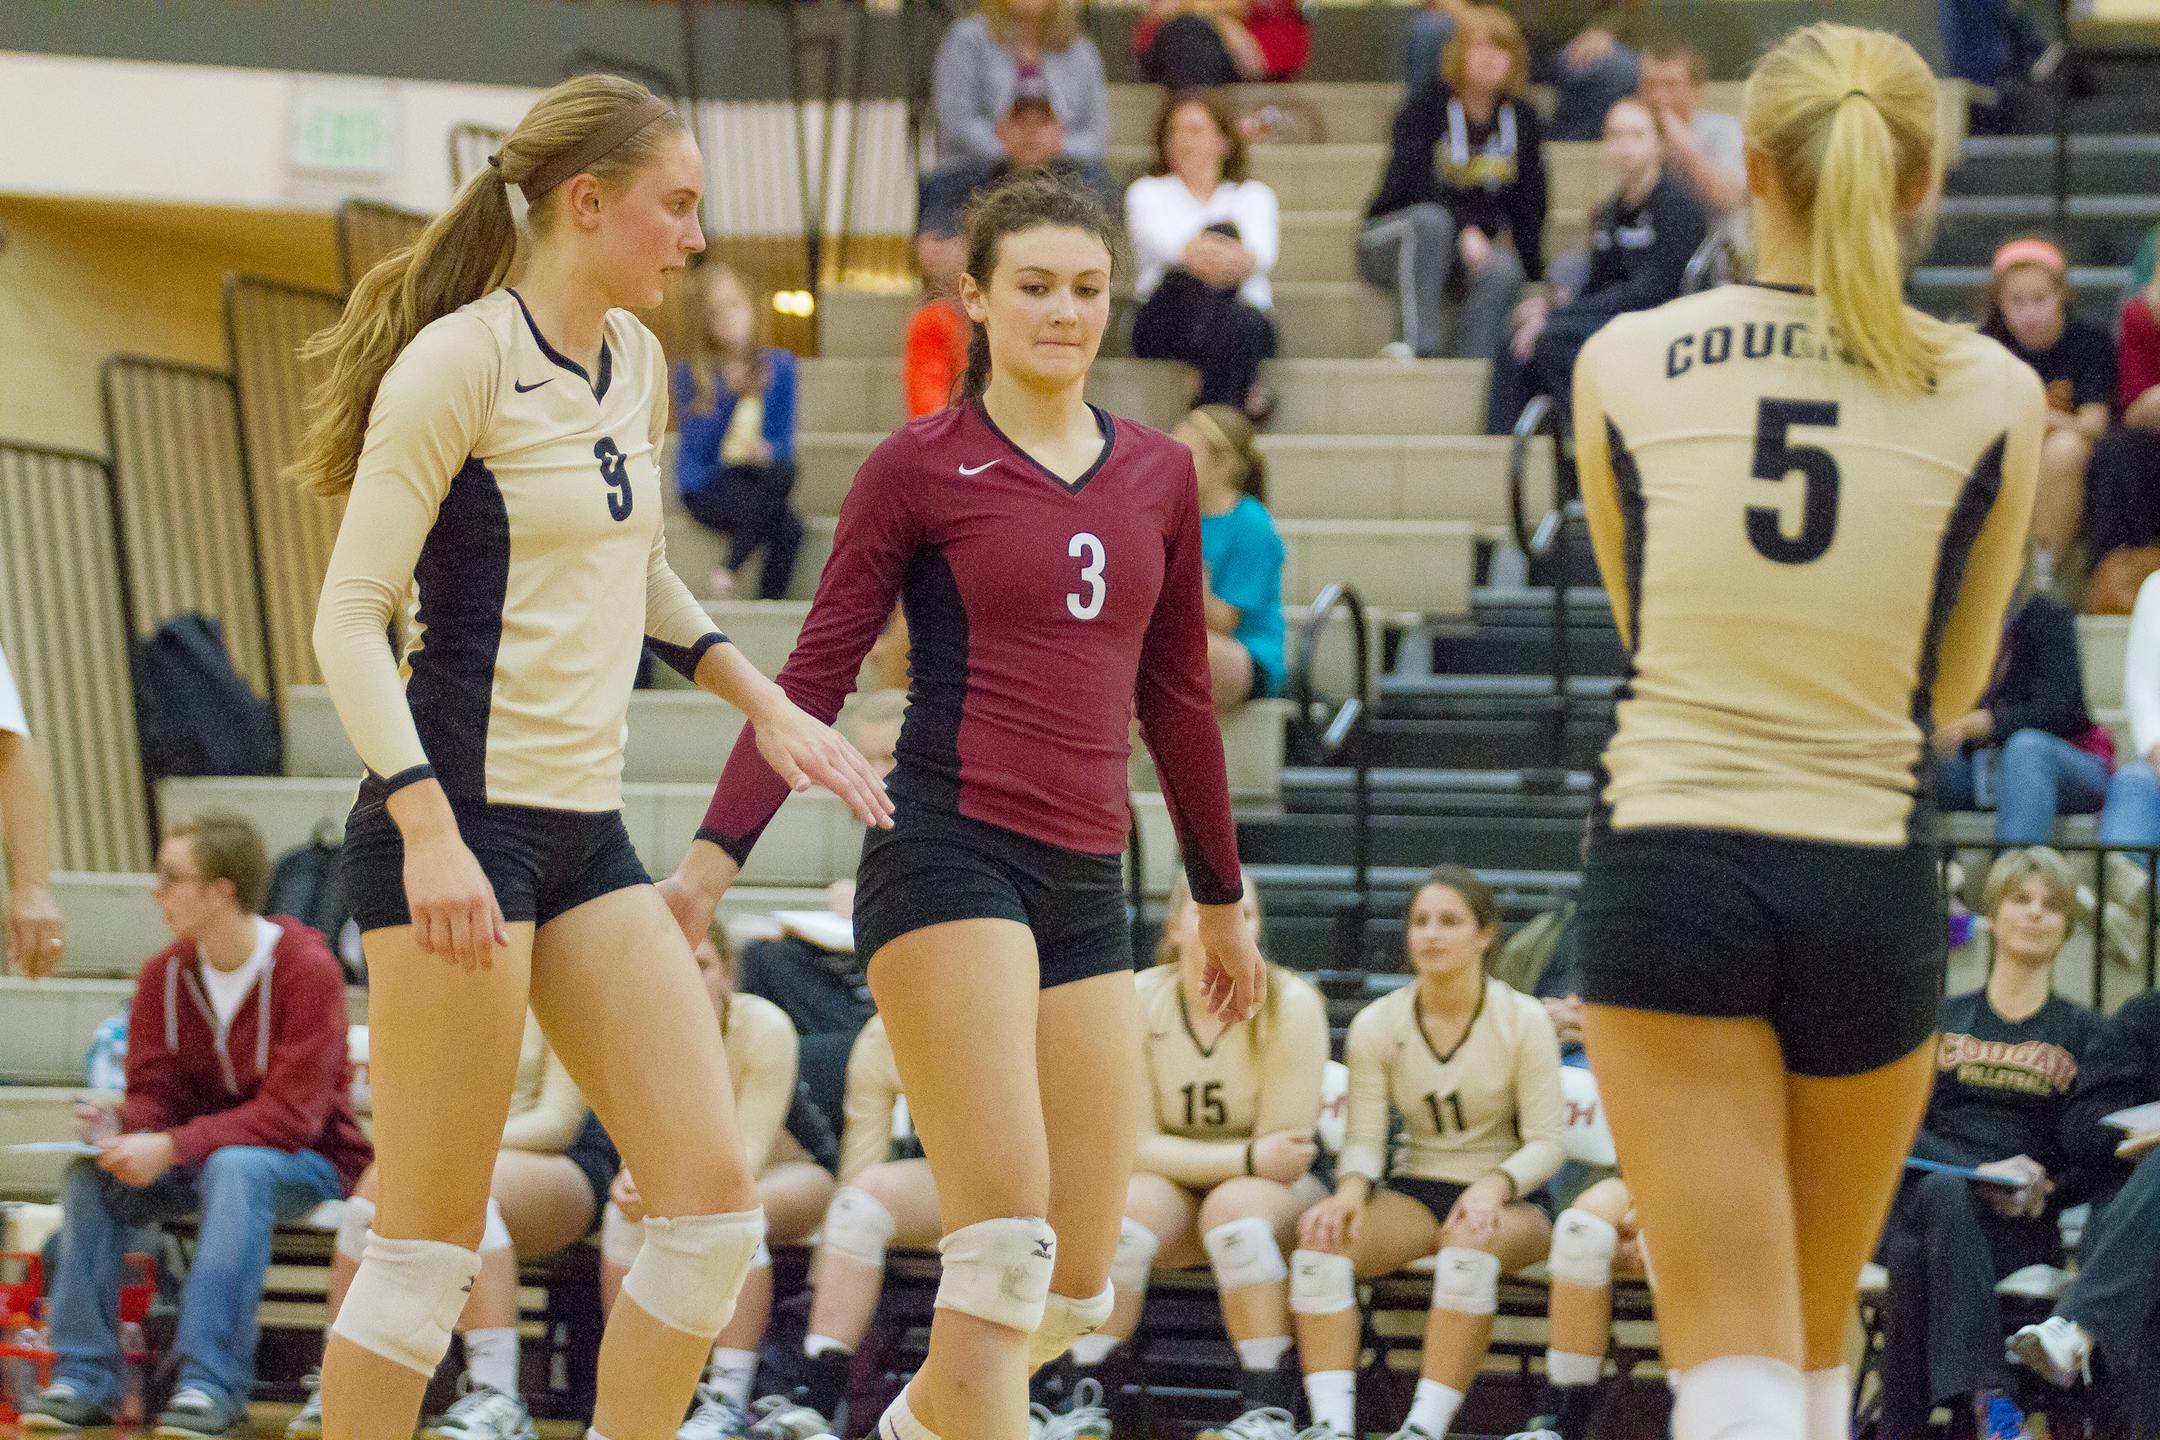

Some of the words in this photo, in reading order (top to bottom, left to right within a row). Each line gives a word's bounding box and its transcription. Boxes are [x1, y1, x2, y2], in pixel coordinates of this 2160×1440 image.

[594, 436, 633, 522] 9
[1745, 397, 1841, 565] 5
[1066, 531, 1106, 621] 3
[1181, 1080, 1228, 1126] 15
[1423, 1090, 1466, 1134] 11
